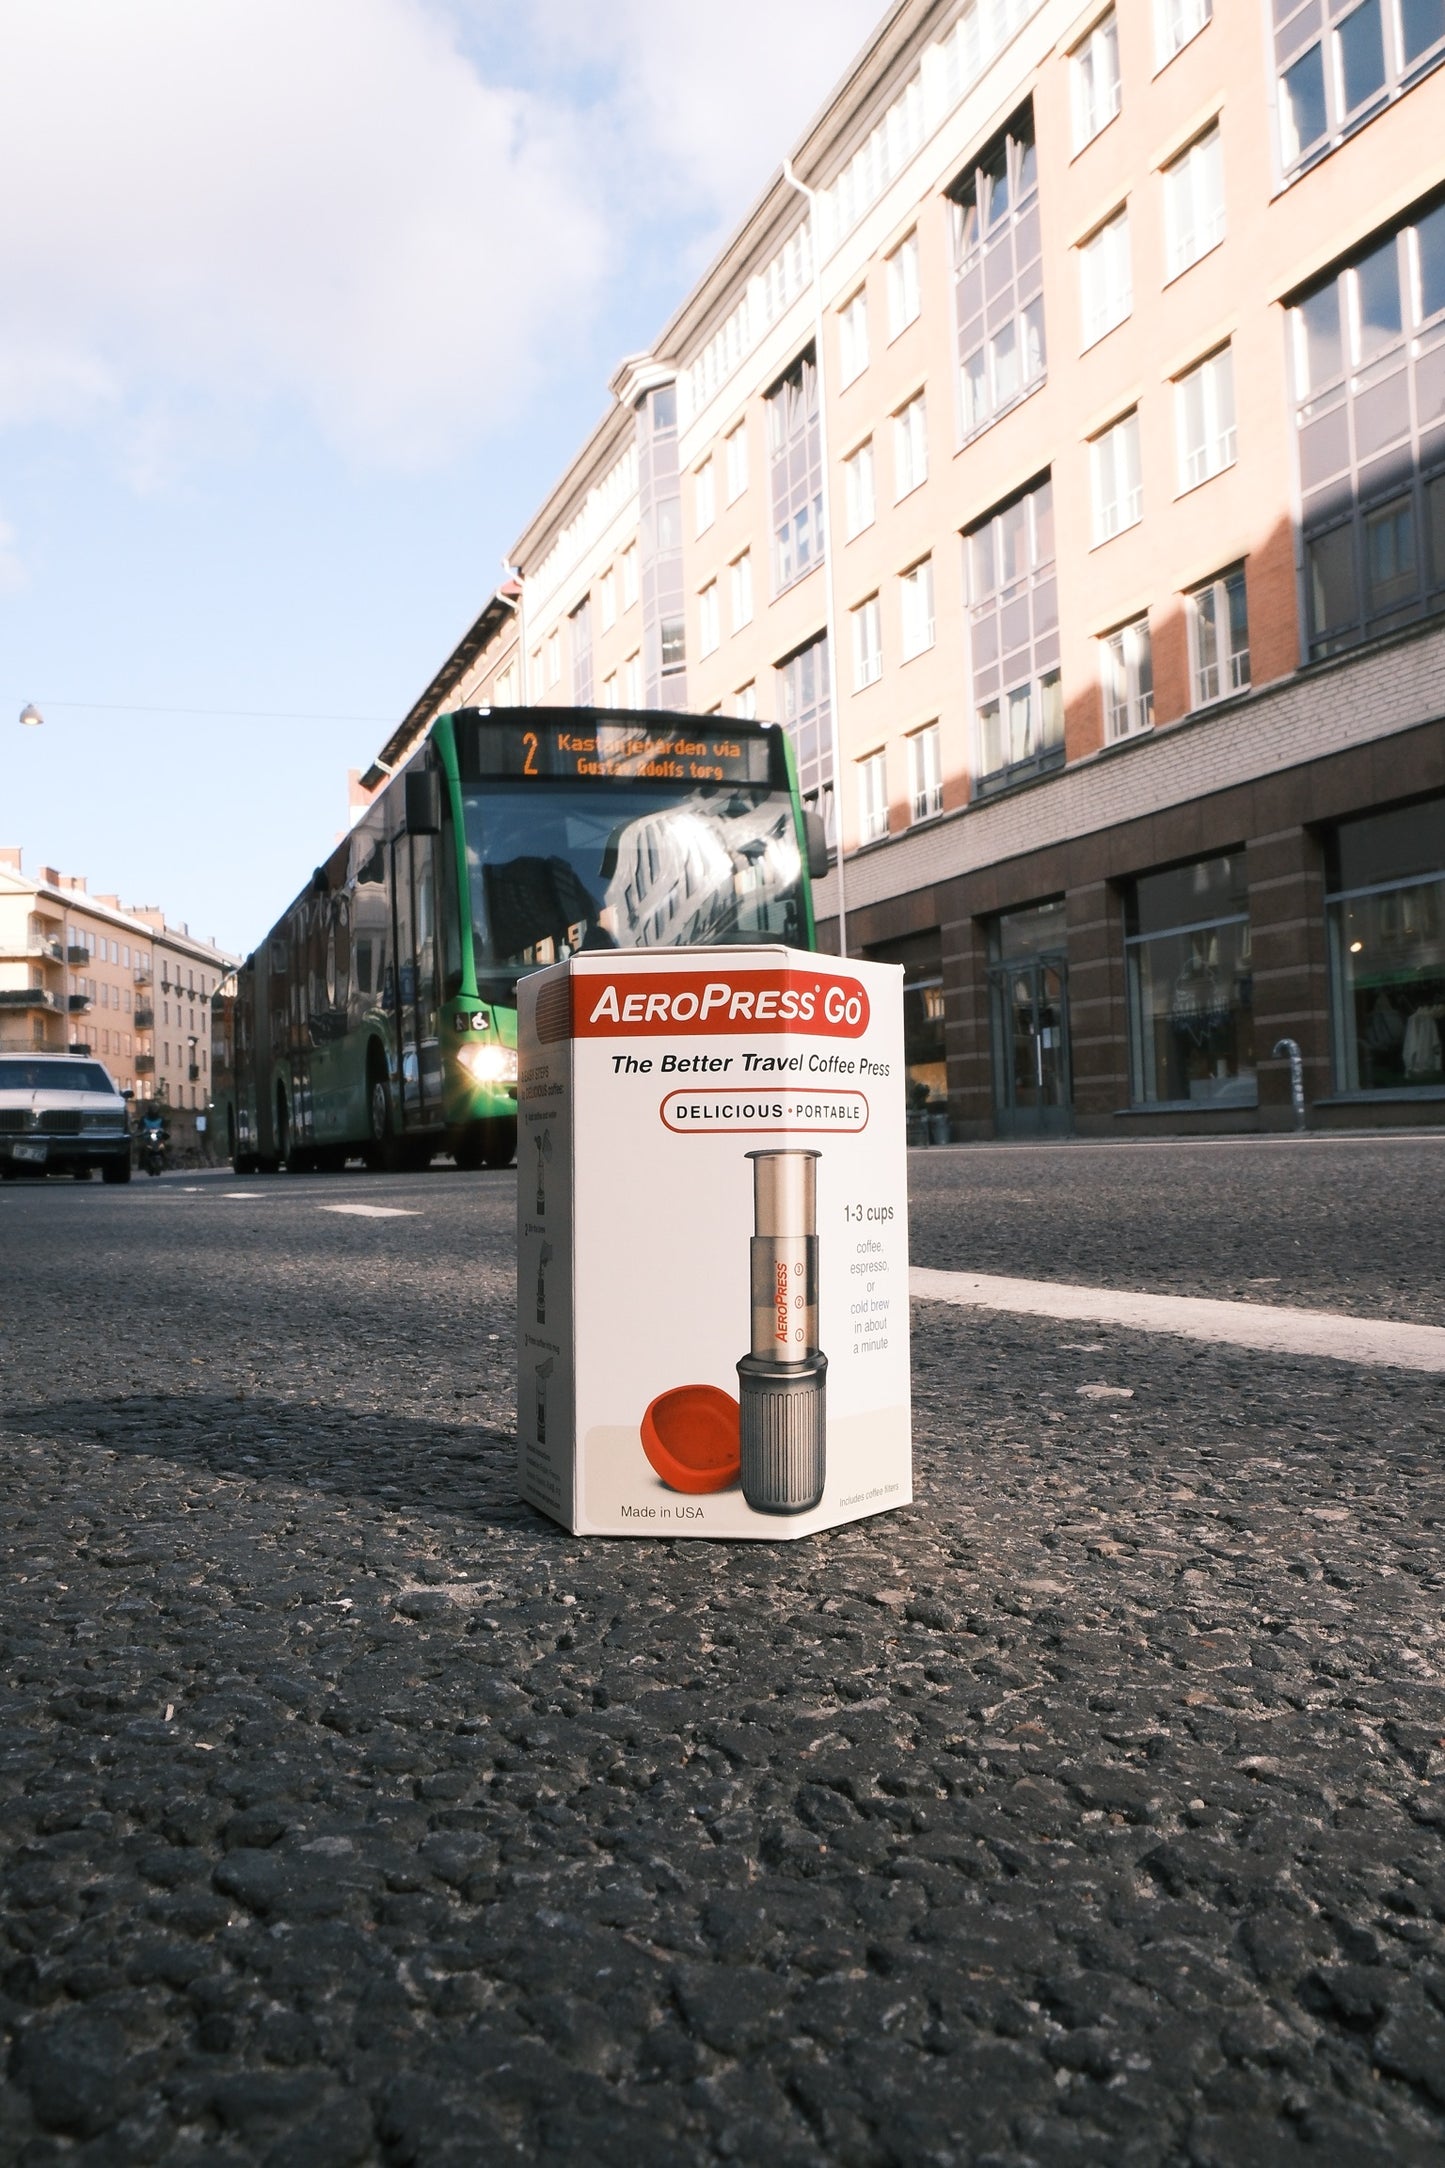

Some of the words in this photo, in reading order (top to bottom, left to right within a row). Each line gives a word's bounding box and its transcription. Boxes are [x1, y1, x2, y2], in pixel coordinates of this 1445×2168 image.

[523, 732, 538, 775] 2
[713, 740, 741, 757] via
[690, 761, 723, 780] torg
[611, 1055, 653, 1074] The
[660, 1054, 734, 1073] Better
[741, 1053, 804, 1072] Travel
[808, 1054, 856, 1075] Coffee
[859, 1057, 891, 1077] Press
[676, 1104, 784, 1119] DELICIOUS
[796, 1104, 860, 1120] PORTABLE
[844, 1203, 863, 1222] 1-3
[866, 1205, 895, 1225] cups
[856, 1239, 884, 1254] coffee,
[850, 1260, 889, 1276] espresso,
[866, 1280, 876, 1293] or
[774, 1263, 788, 1343] AEROPRESS
[850, 1299, 869, 1315] cold
[870, 1299, 890, 1313] brew
[854, 1320, 863, 1334] in
[864, 1316, 888, 1333] about
[853, 1343, 859, 1354] a
[861, 1337, 889, 1353] minute
[839, 1493, 865, 1508] Includes
[620, 1505, 656, 1518] Made
[660, 1505, 671, 1518] in
[675, 1506, 705, 1519] USA
